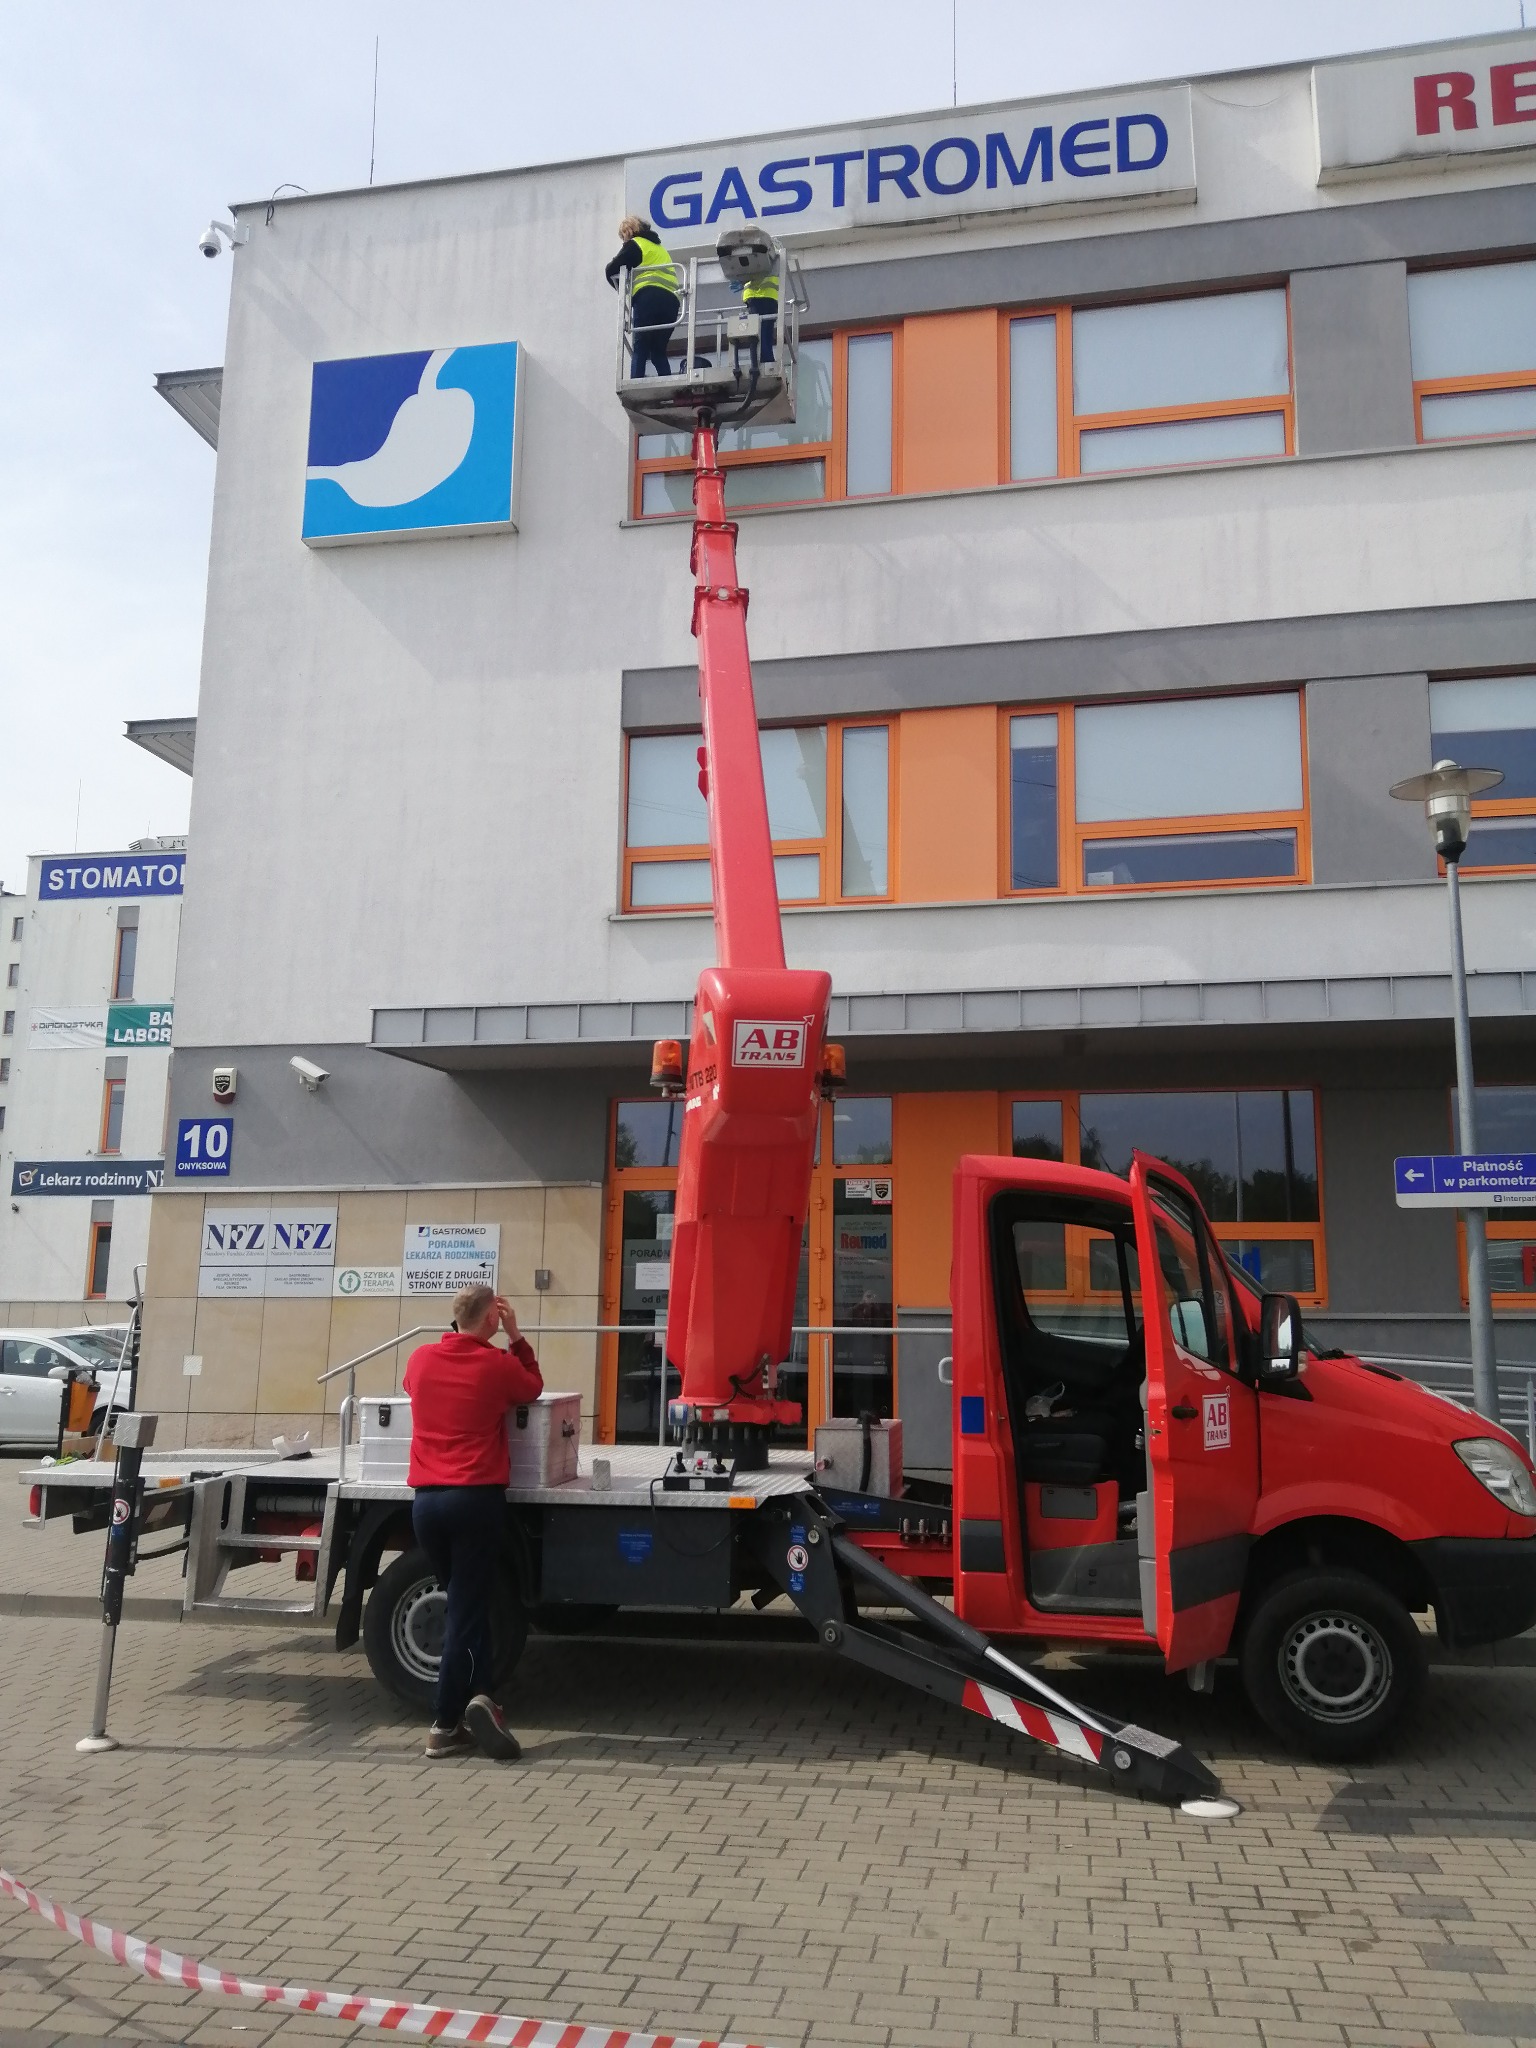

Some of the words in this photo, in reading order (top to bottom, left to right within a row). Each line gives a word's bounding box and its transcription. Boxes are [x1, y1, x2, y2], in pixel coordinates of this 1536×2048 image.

[649, 113, 1169, 229] GASTROMED
[741, 1028, 800, 1050] AB
[739, 1051, 797, 1061] TRANS
[184, 1124, 229, 1158] 10
[178, 1161, 227, 1170] ONYKSOWA
[1463, 1160, 1524, 1172] Płatność
[40, 1173, 82, 1186] Lekarz
[85, 1172, 143, 1188] rodzinny
[1443, 1178, 1456, 1187] w
[206, 1223, 266, 1250] NFZ
[271, 1223, 333, 1250] NFZ
[432, 1227, 487, 1236] GASTROMED
[428, 1240, 475, 1249] PORADNIA
[405, 1251, 443, 1260] LEKARZA
[444, 1250, 497, 1260] RODZINNEGO
[363, 1271, 395, 1279] SZYBKA
[406, 1269, 444, 1280] WEJŚCIE
[446, 1271, 452, 1279] Z
[454, 1270, 491, 1279] DRUGIEJ
[408, 1281, 444, 1289] STRONY
[1206, 1402, 1228, 1427] AB
[1206, 1429, 1228, 1441] TRANS
